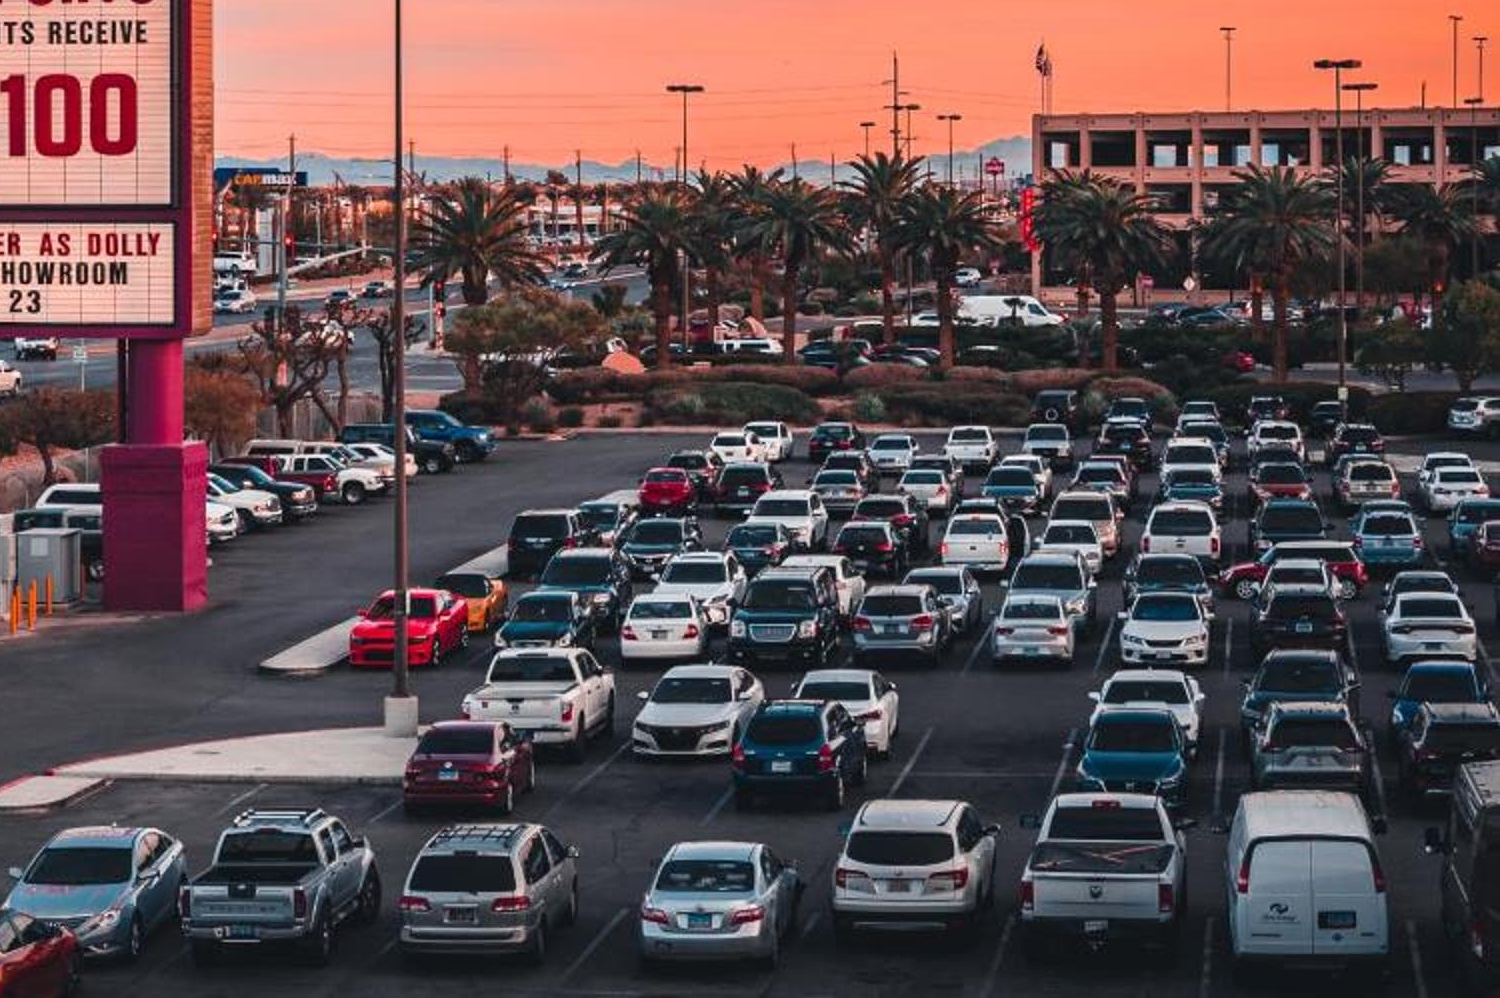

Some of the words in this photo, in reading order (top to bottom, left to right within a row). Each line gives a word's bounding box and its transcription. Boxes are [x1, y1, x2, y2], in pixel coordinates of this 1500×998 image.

[48, 20, 148, 44] RECEIVE
[39, 232, 71, 256] AS
[88, 232, 161, 256] DOLLY
[9, 290, 41, 313] 23
